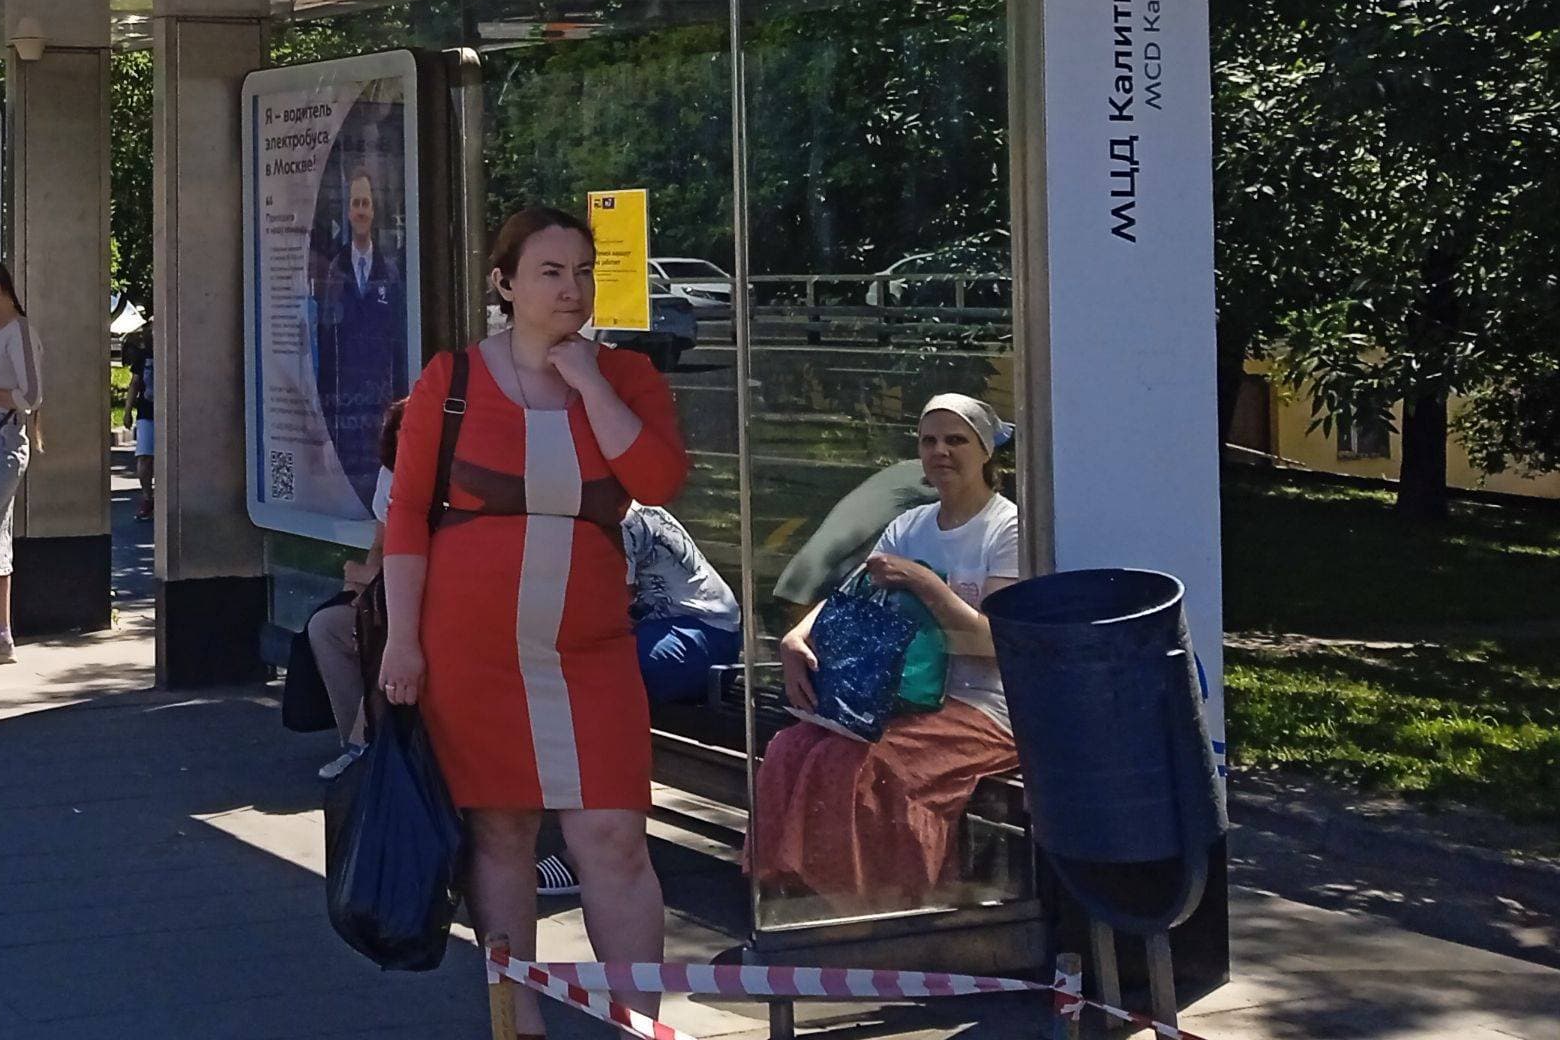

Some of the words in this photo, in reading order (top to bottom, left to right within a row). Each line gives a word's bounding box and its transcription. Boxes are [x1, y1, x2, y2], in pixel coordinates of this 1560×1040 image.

[1144, 41, 1162, 111] MCD
[265, 107, 273, 125] Я
[283, 103, 333, 124] водитель
[265, 128, 330, 151] электробуса
[266, 166, 271, 176] в
[273, 155, 317, 175] Москве!
[1109, 135, 1139, 243] МЦД
